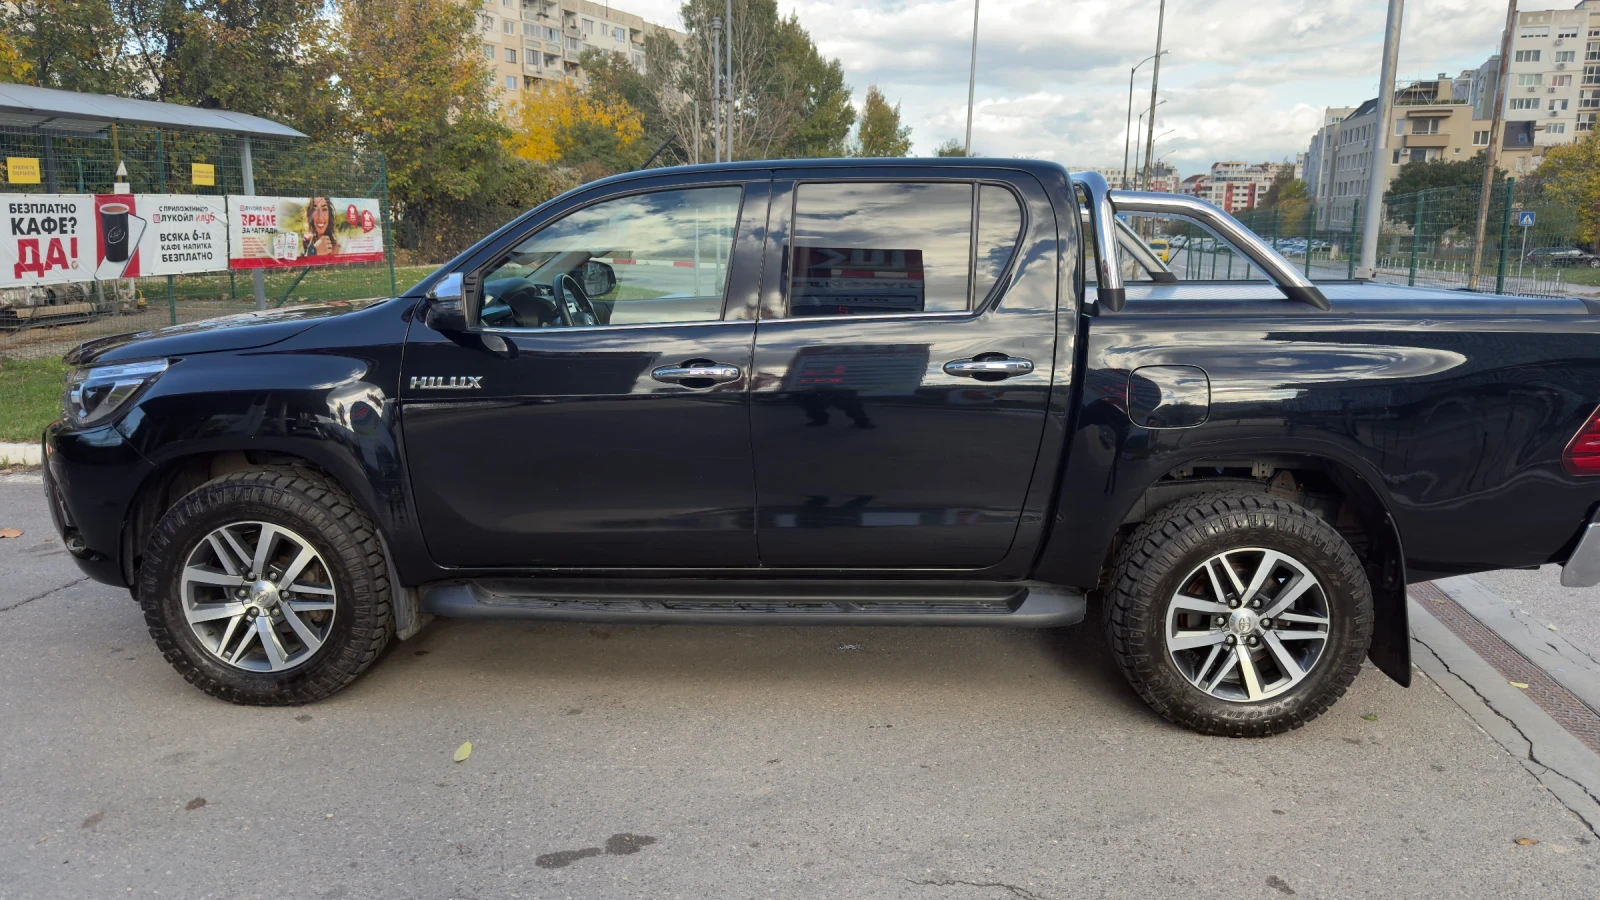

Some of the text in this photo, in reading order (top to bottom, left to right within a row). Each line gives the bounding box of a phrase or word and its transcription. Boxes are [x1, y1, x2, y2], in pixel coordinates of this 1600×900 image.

[9, 203, 77, 214] БЕЗПЛАТНО
[161, 212, 216, 224] ЛУКОЙЛ клуб
[241, 213, 276, 226] ВРЕМЕ
[11, 216, 78, 236] КАФЕ?
[160, 229, 211, 242] ВСЯКА 6-ТА
[161, 242, 212, 251] КАФЕ НАПИТКА
[14, 237, 79, 279] ДА!
[161, 252, 213, 263] БЕЗПЛАТНО
[409, 375, 483, 390] HILUX
